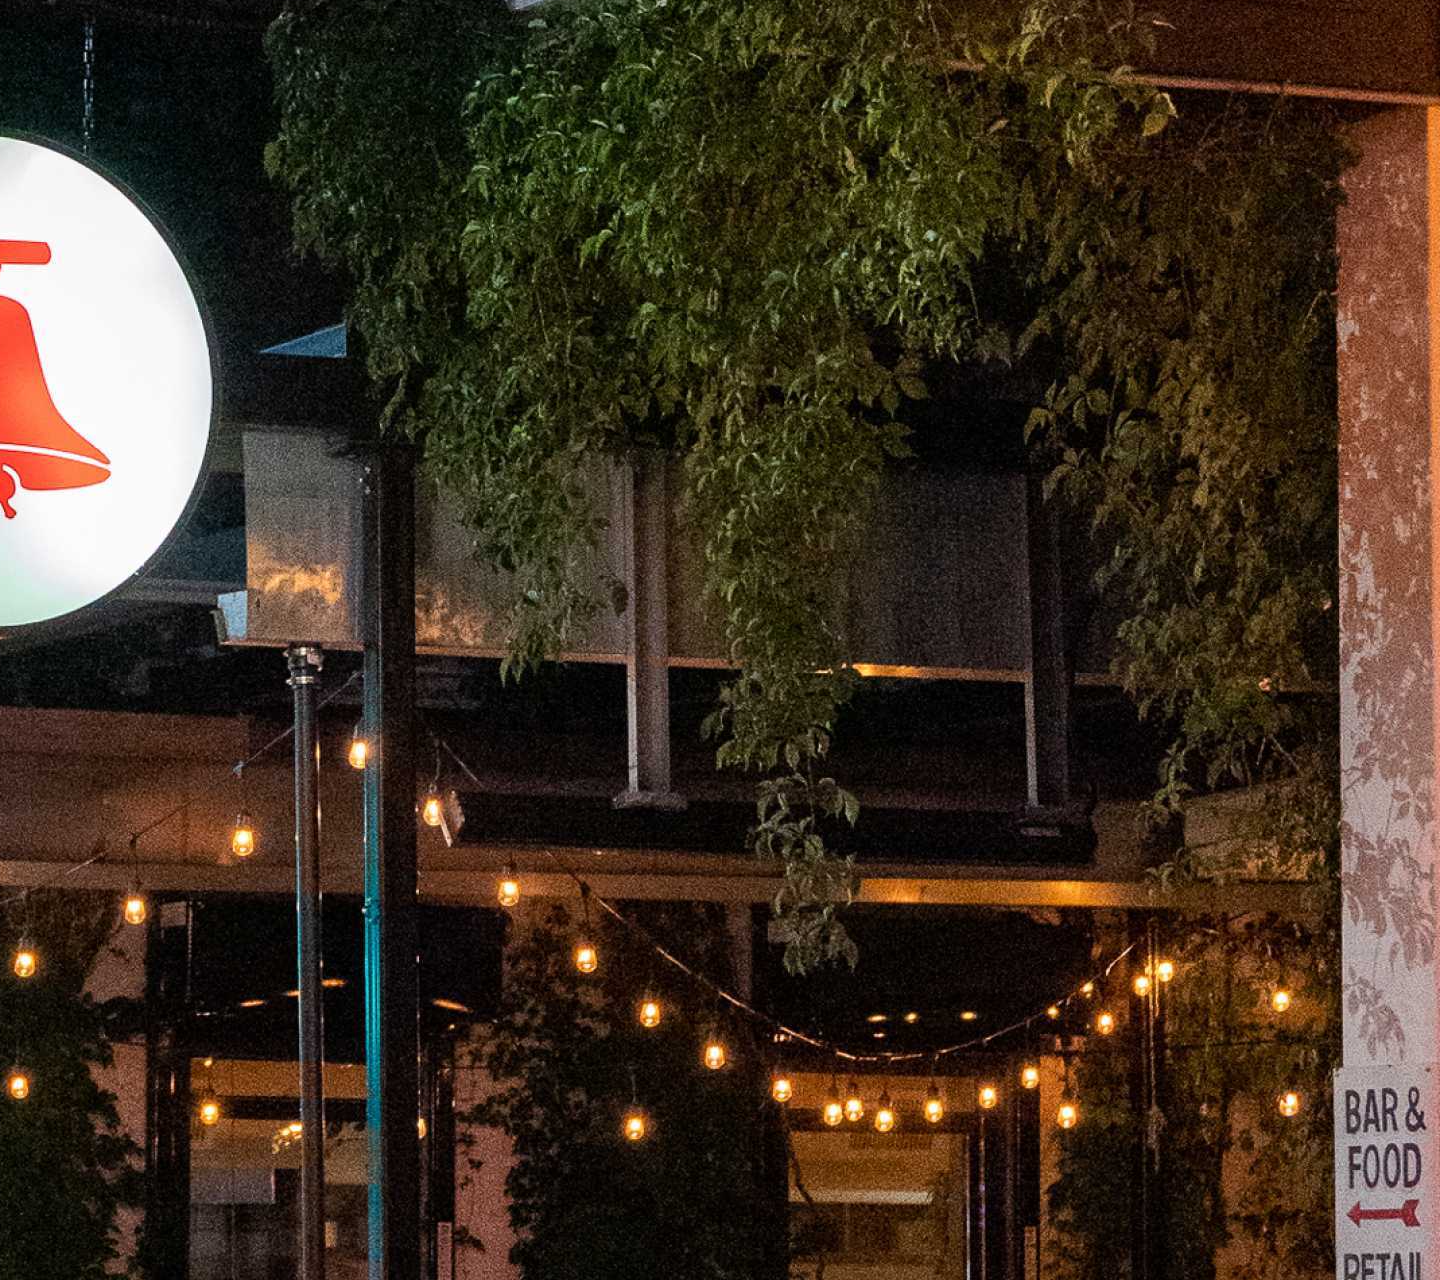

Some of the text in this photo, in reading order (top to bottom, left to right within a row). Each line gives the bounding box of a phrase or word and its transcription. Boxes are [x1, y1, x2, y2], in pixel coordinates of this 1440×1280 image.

[1345, 1086, 1426, 1134] BAR &
[1348, 1142, 1421, 1189] FOOD
